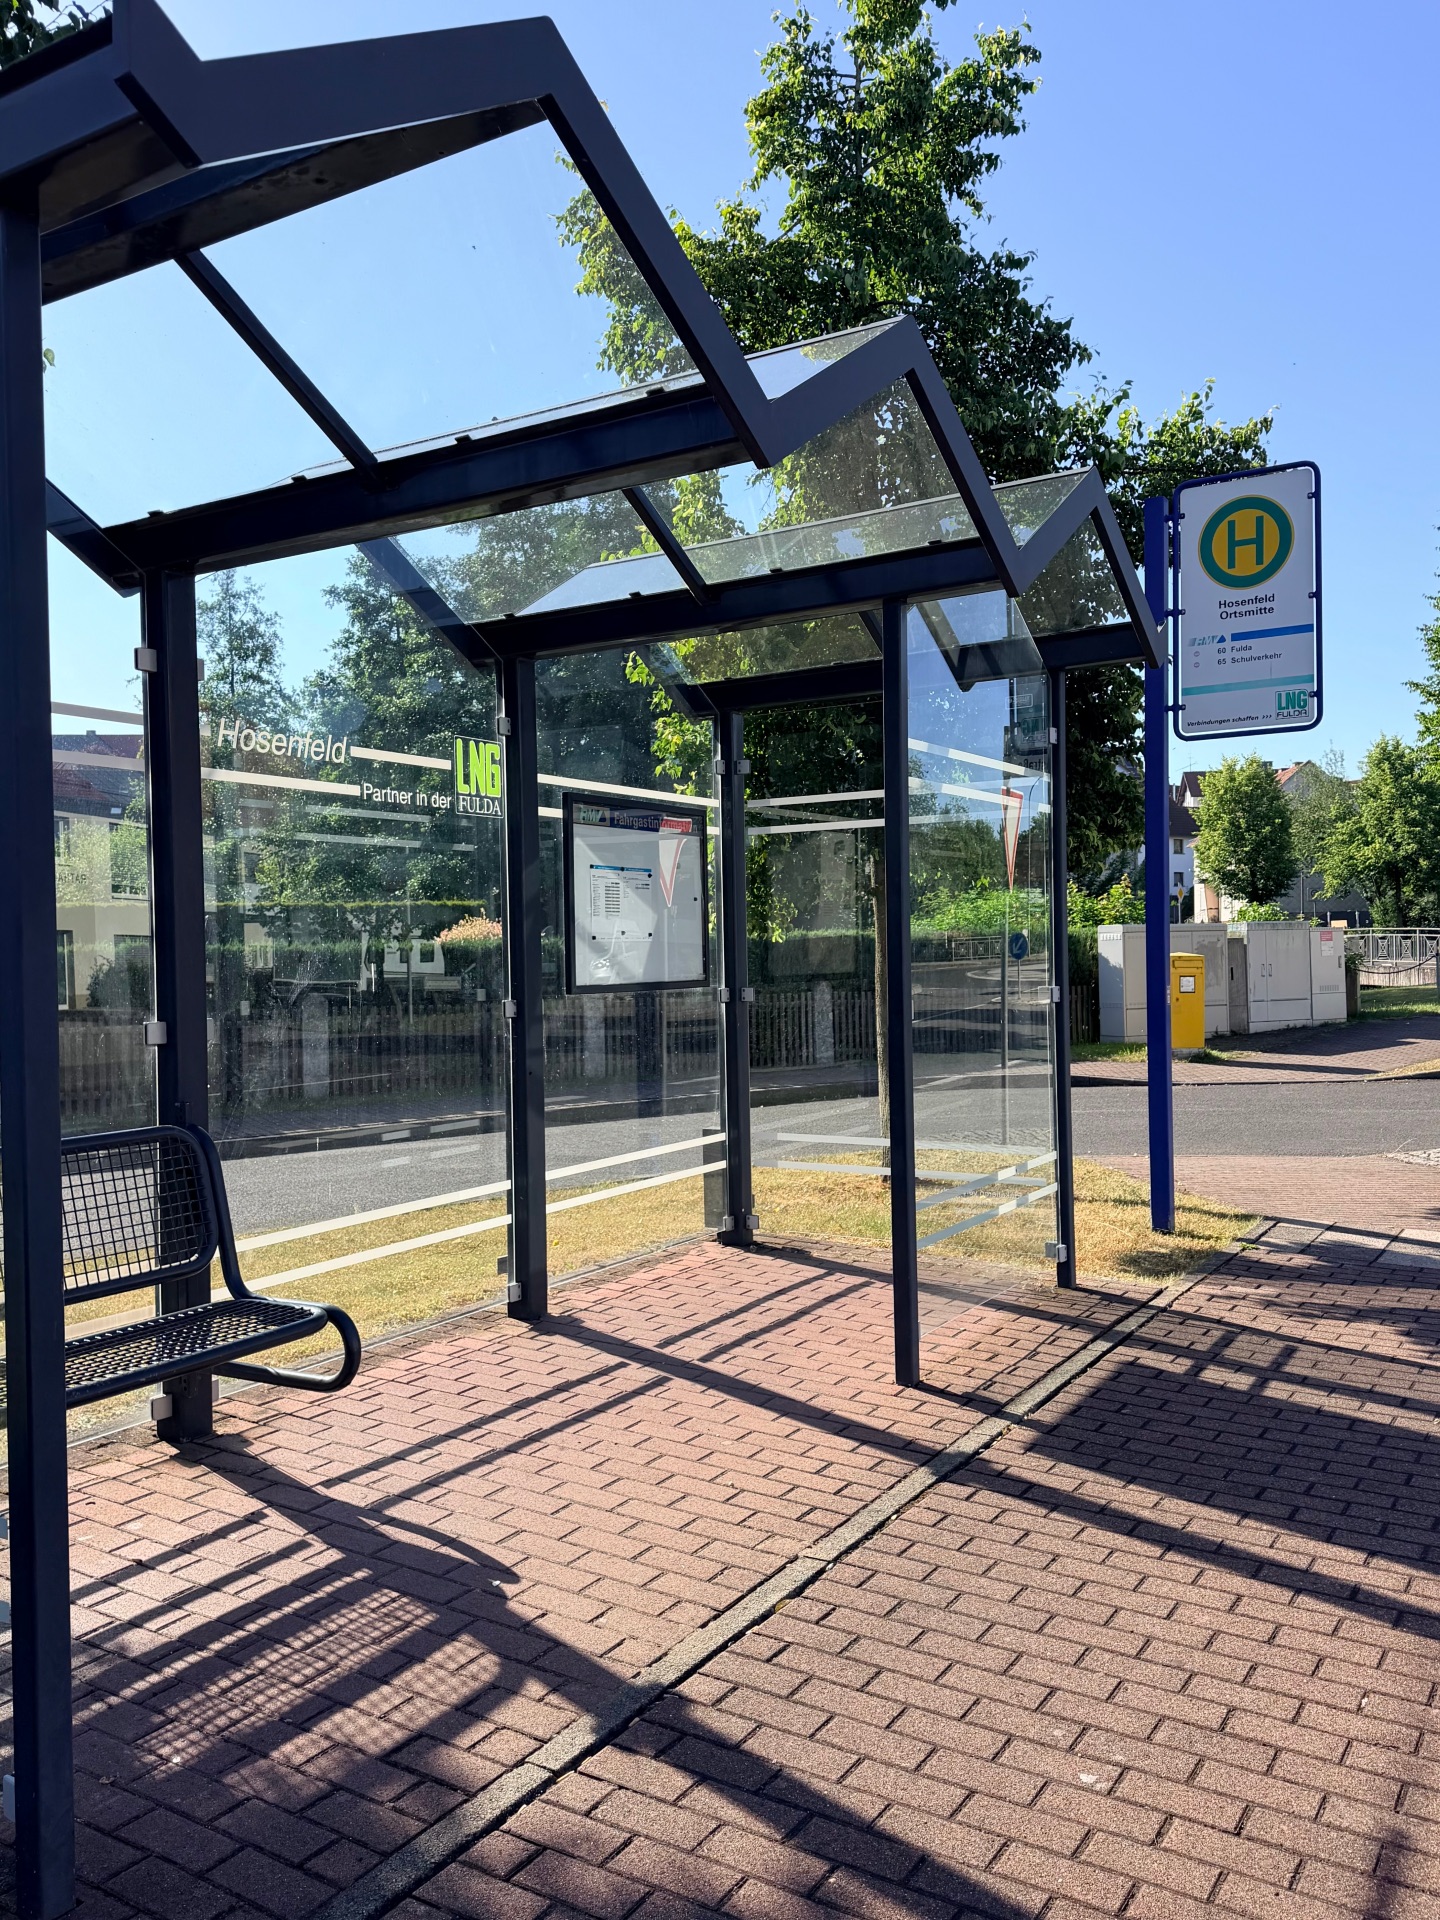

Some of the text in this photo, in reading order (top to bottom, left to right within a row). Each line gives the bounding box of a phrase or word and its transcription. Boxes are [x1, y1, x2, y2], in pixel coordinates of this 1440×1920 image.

[1227, 515, 1264, 569] H
[1218, 593, 1275, 609] Hosenfeld
[1219, 606, 1275, 620] Ortsmitte
[1217, 652, 1282, 666] 65 Schulverkehr
[1230, 645, 1253, 653] Fulda
[1277, 690, 1308, 711] LNG
[1187, 715, 1259, 727] Verbindungen schaffen
[1276, 709, 1308, 718] FULDA
[217, 717, 347, 764] Hosenfeld
[456, 738, 502, 798] LNG
[363, 782, 452, 809] Partner in der
[459, 795, 502, 815] FULDA
[614, 811, 698, 834] Fahrgastinformatin
